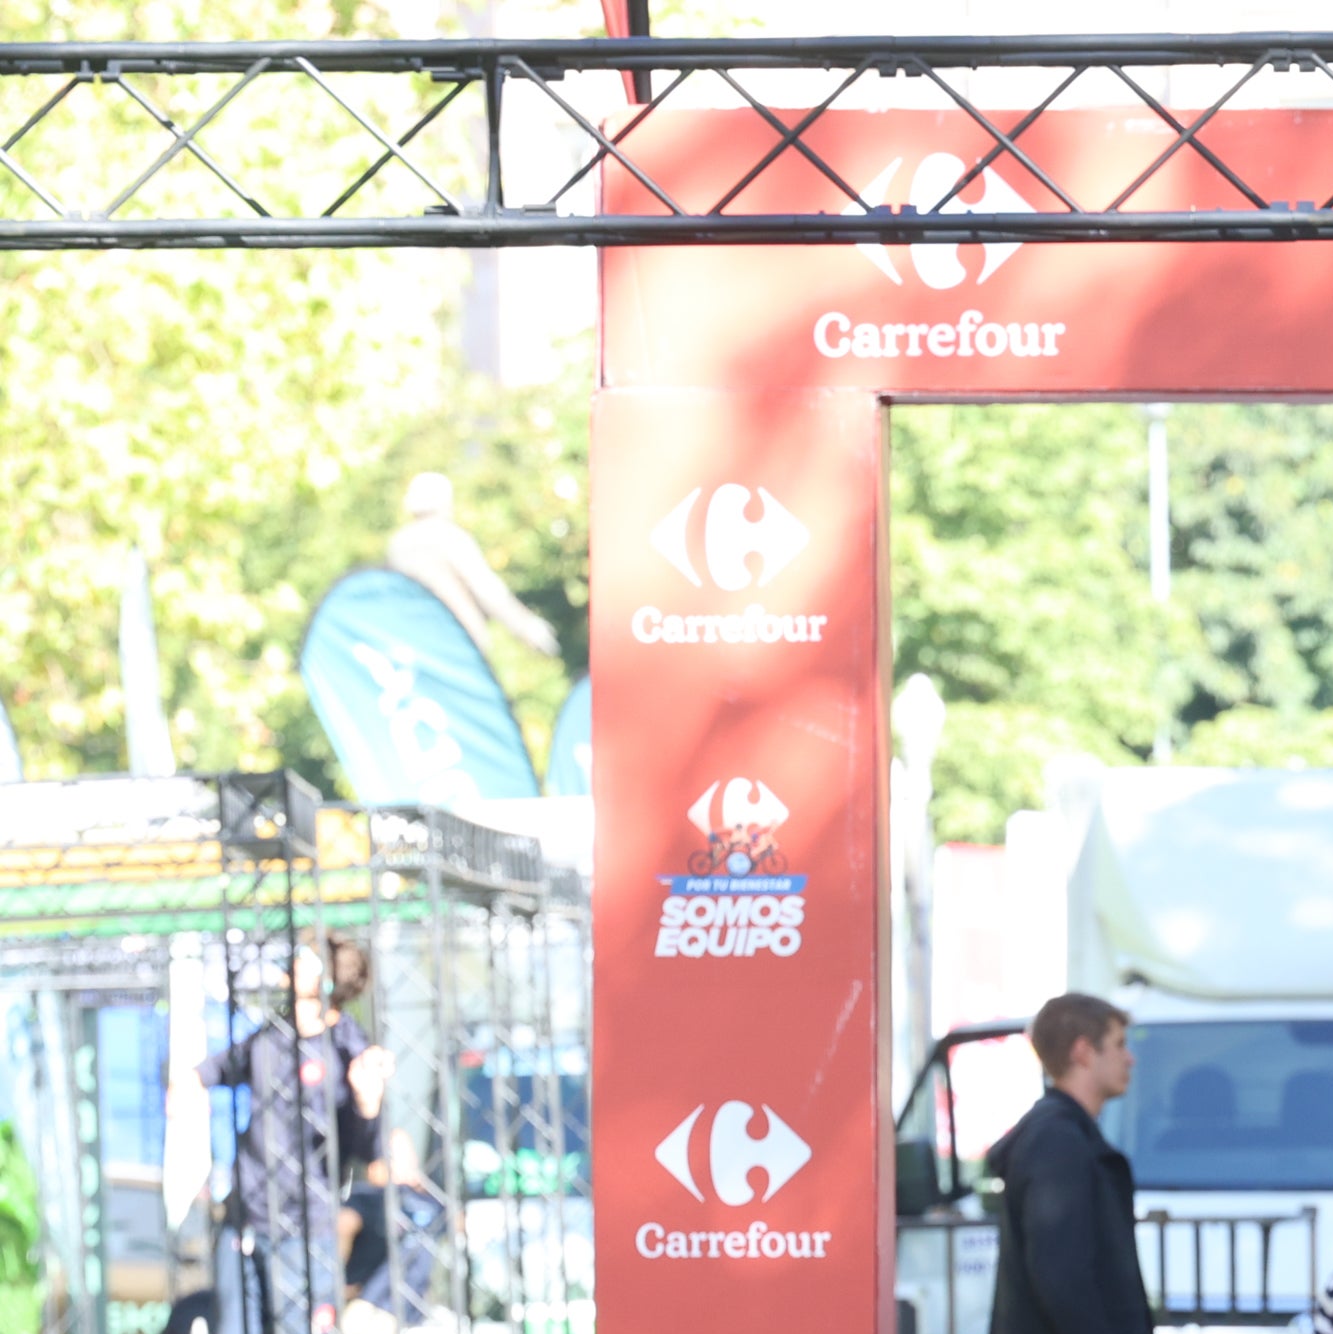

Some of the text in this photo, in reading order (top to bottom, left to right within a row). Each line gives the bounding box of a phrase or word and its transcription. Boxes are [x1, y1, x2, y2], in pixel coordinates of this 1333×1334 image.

[813, 310, 1065, 358] Carrefour
[631, 604, 827, 643] Carrefour
[686, 878, 792, 891] POR TU BIENESTAR
[659, 895, 806, 928] SOMOS
[654, 926, 802, 958] EQUIPO
[635, 1221, 831, 1259] Carrefour
